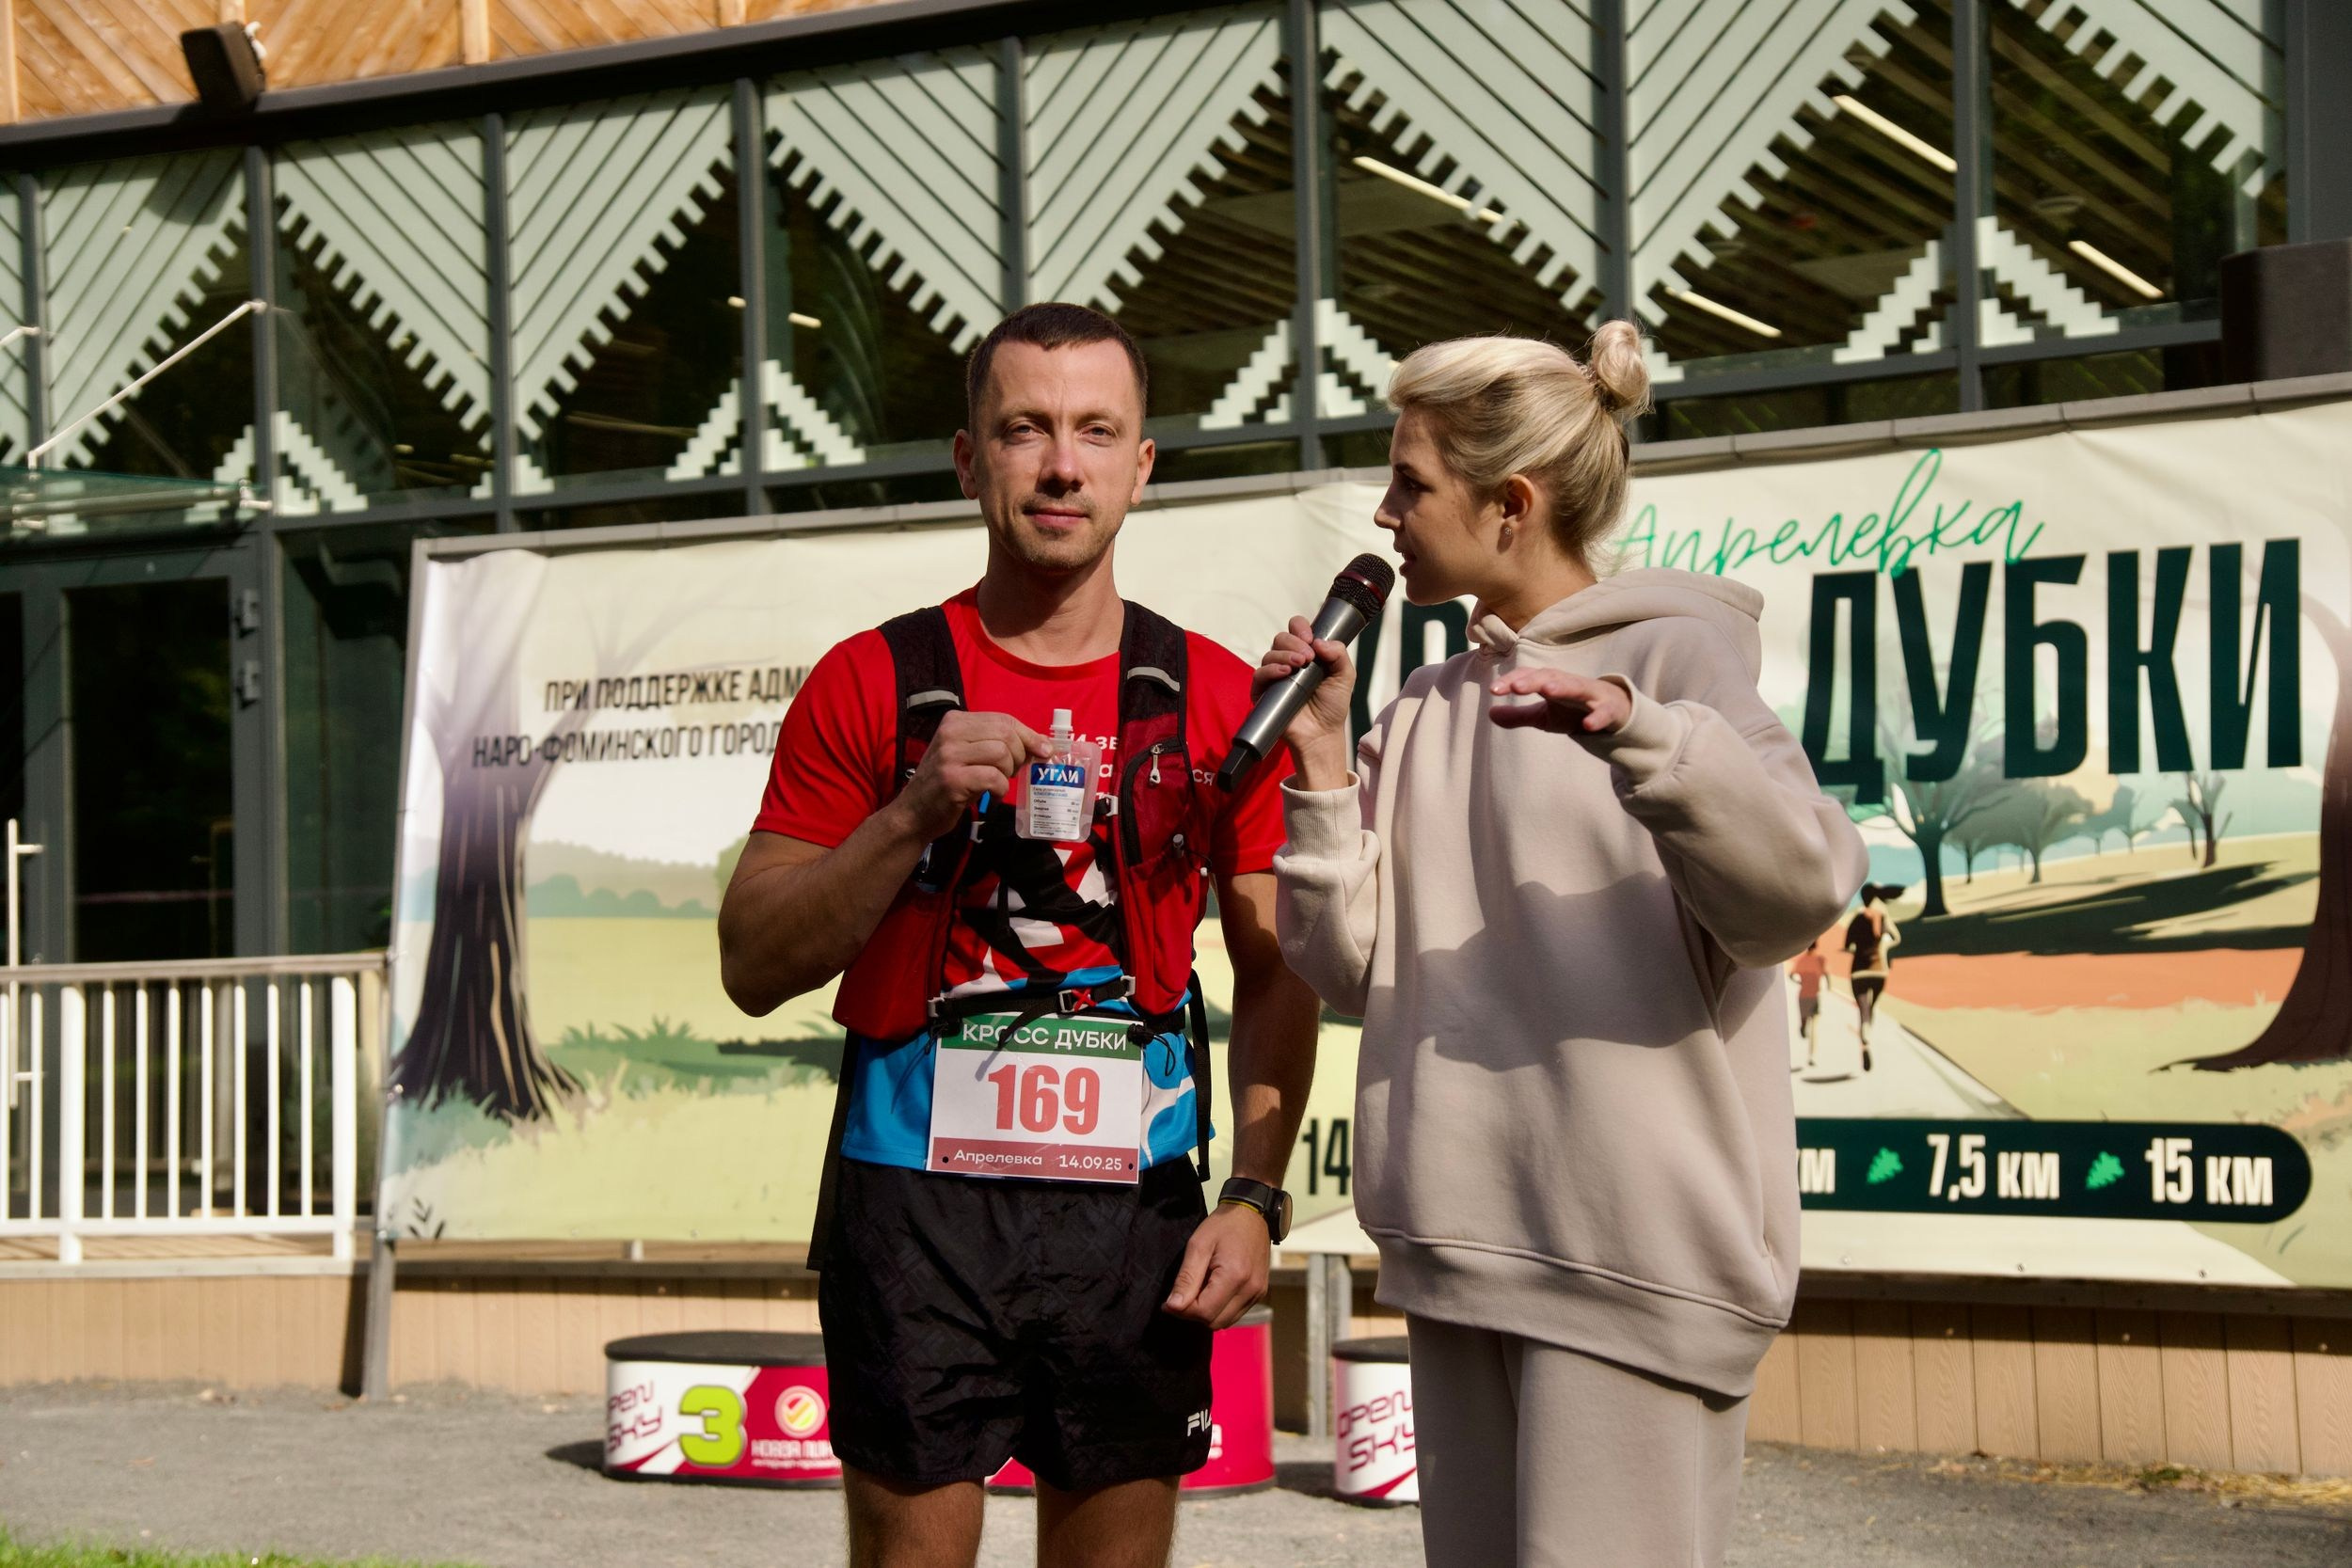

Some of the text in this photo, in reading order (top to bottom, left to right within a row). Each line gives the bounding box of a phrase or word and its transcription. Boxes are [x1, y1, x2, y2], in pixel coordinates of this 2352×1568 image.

[1611, 448, 2045, 578] Апрелевка
[544, 666, 811, 711] ПРИ ПОДДЕРЖКЕ АДМ
[1801, 537, 2303, 805] ДУБКИ
[472, 724, 704, 768] НАРО-ФОМИНСКОГО
[1038, 767, 1079, 784] УГЛИ
[1054, 1027, 1127, 1052] ДУБКИ
[988, 1064, 1101, 1135] 169
[953, 1148, 1122, 1172] Апрелевка 14.09.25
[1301, 1117, 1351, 1196] 14
[1926, 1133, 1987, 1202] 7,5
[2144, 1136, 2194, 1205] 15
[678, 1385, 745, 1467] 3
